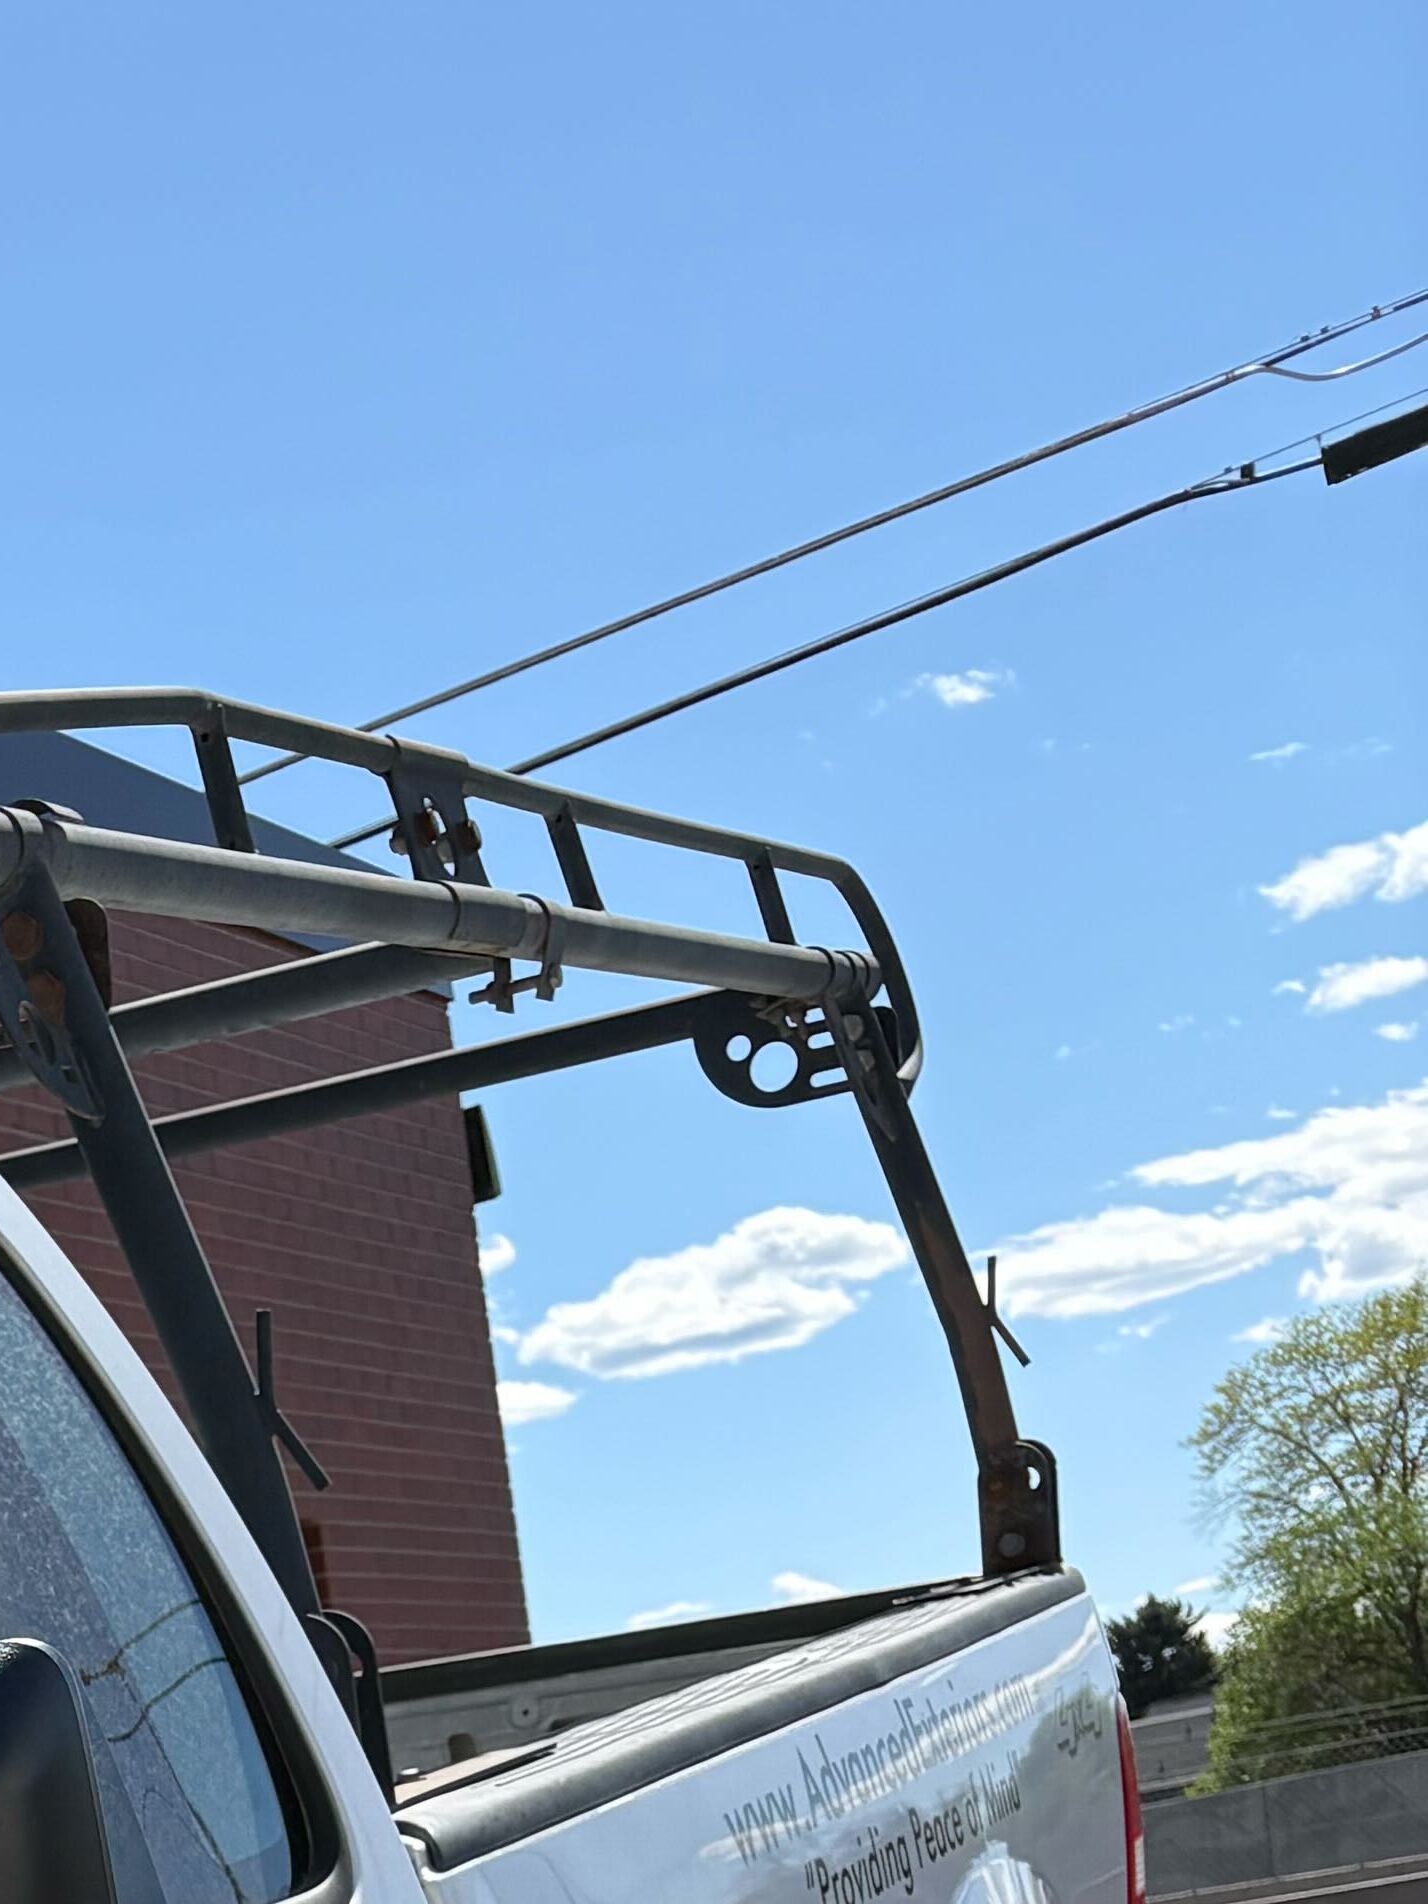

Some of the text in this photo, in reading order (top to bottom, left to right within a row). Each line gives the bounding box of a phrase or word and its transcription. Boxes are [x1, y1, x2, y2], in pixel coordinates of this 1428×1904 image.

[724, 1672, 1035, 1866] www.AdvancedExteriors.com
[910, 1807, 964, 1868] Peace
[964, 1770, 985, 1838] of
[981, 1750, 1023, 1824] Mind"
